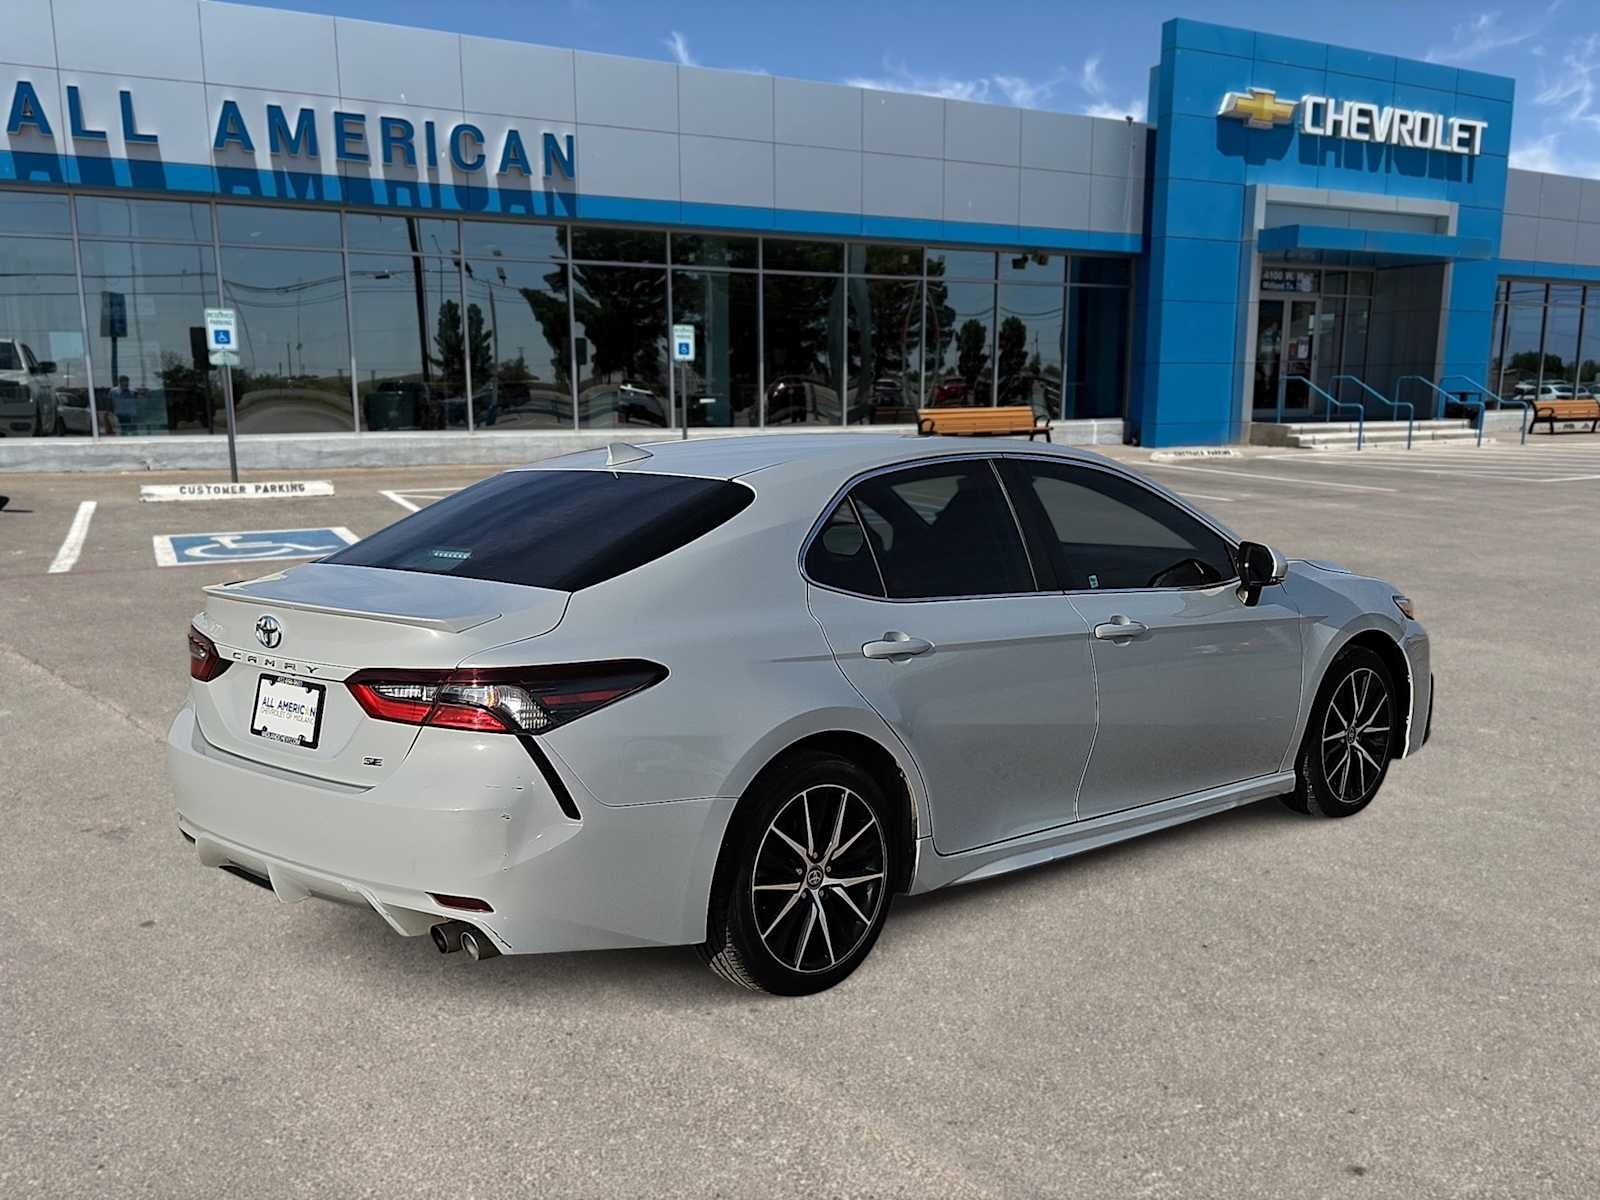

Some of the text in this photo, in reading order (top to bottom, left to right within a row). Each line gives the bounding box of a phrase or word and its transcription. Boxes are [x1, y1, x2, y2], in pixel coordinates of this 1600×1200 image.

[7, 80, 575, 178] ALL AMERICAN
[1301, 94, 1488, 155] CHEVROLET
[179, 483, 306, 496] CUSTOMER PARKING
[232, 651, 320, 674] CAMRY
[261, 696, 316, 718] ALL AMERICAN
[363, 757, 383, 767] SE
